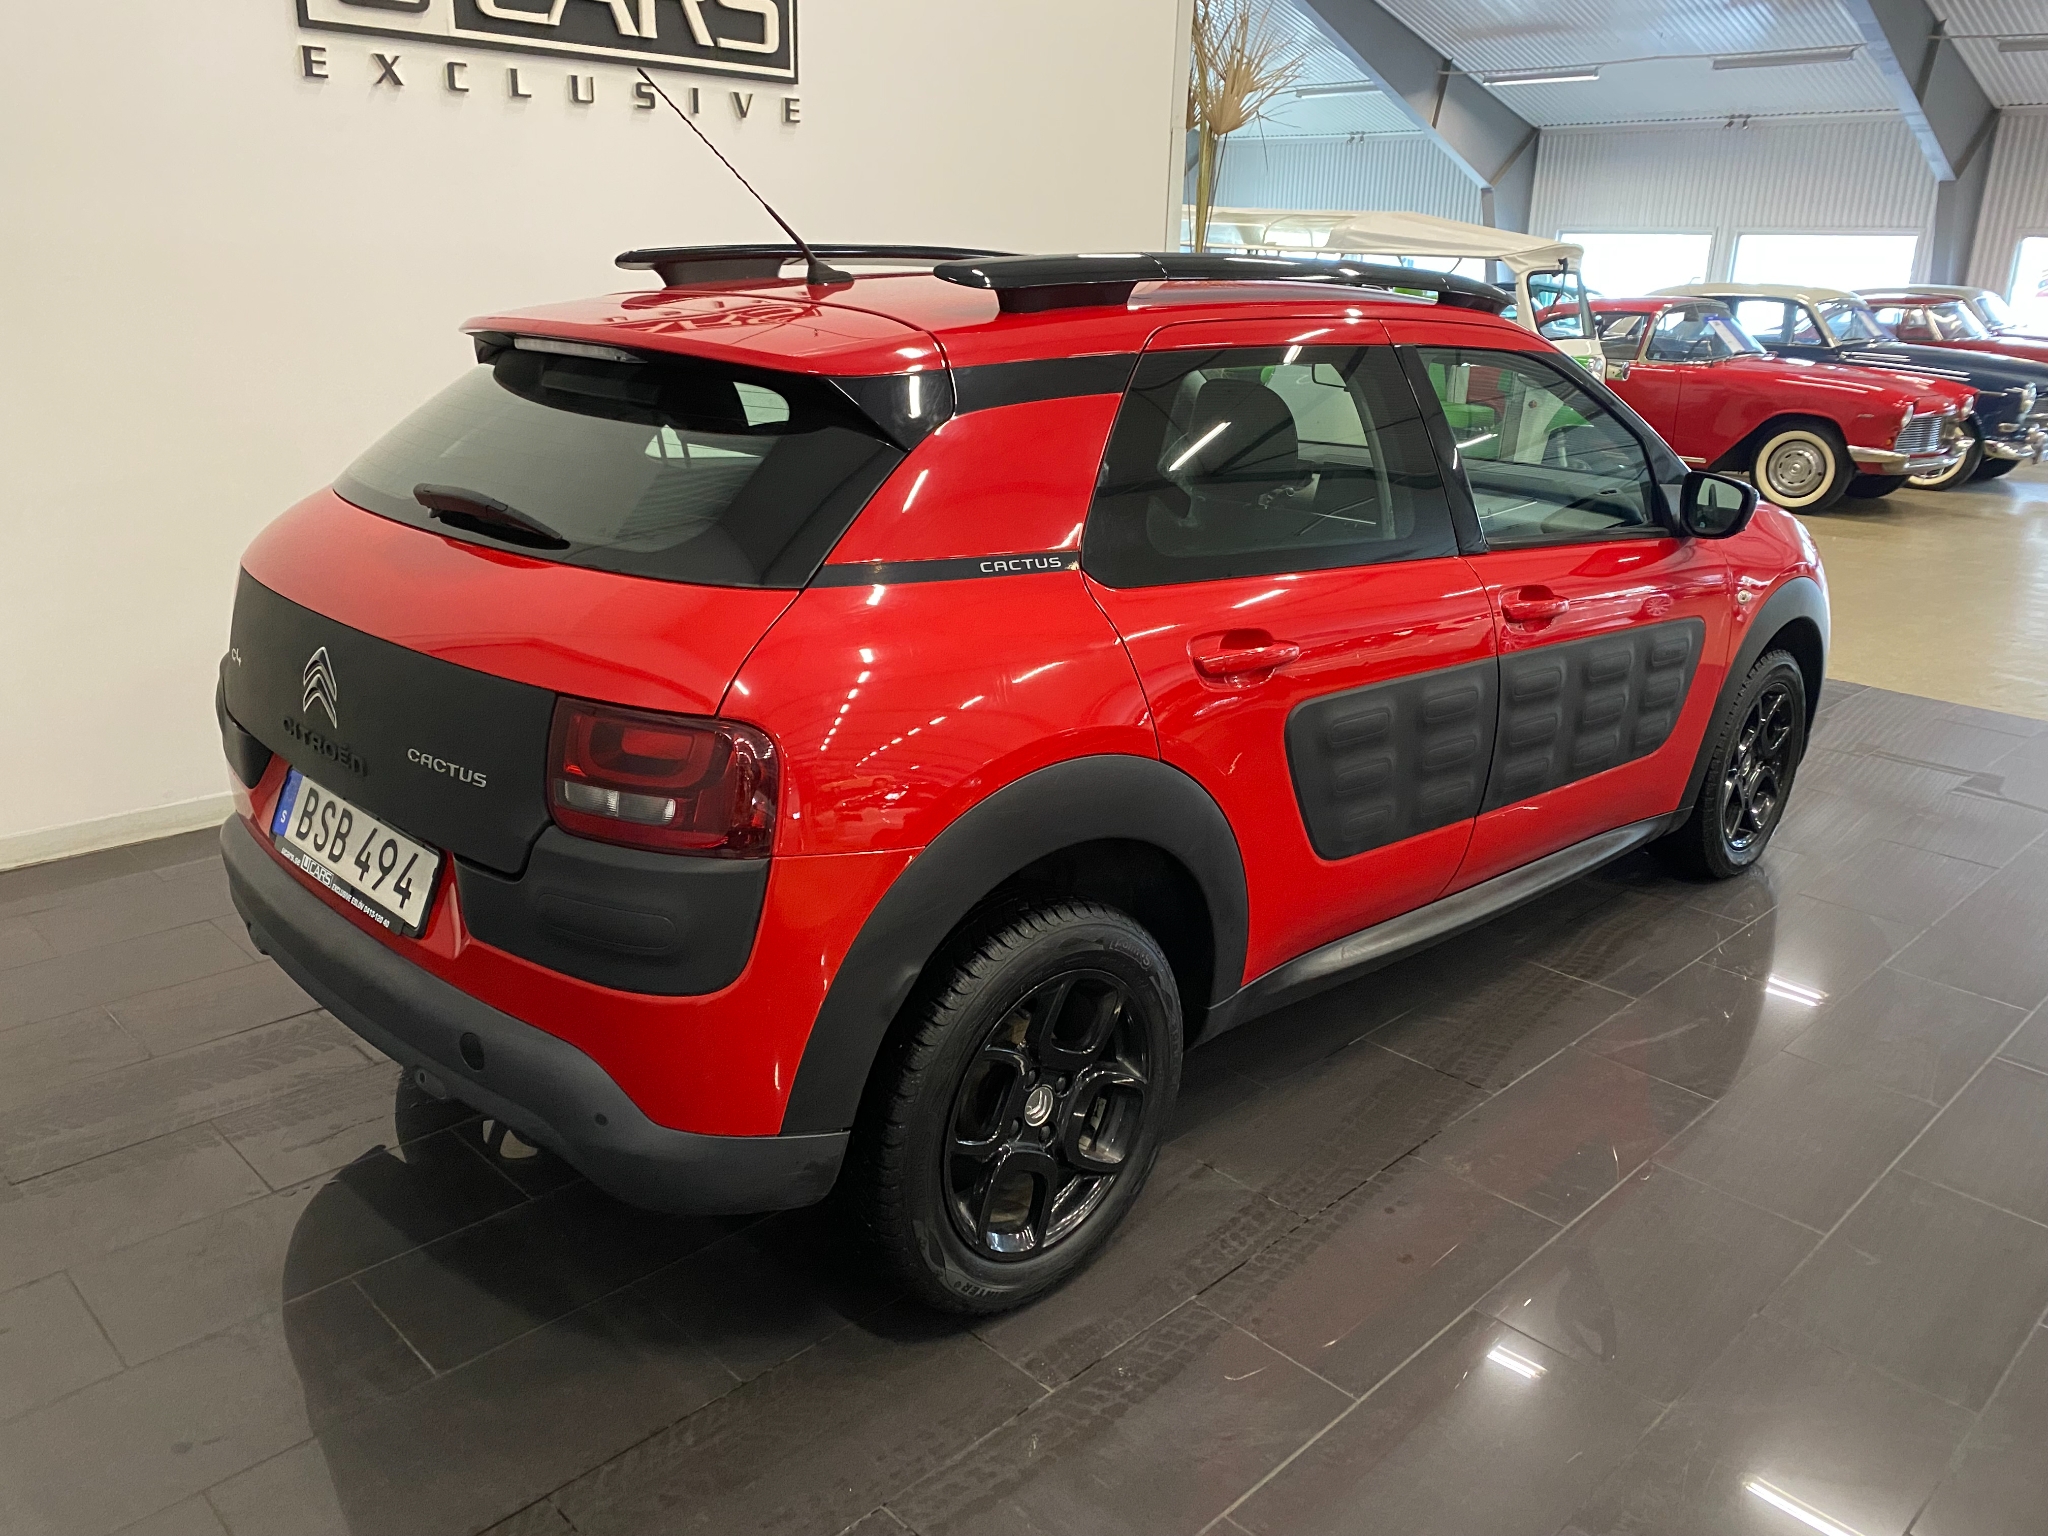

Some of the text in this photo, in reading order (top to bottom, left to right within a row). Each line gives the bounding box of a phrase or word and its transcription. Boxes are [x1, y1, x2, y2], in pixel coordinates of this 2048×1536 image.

[301, 45, 801, 124] EXCLUSIVE
[979, 557, 1062, 573] CACTUS
[231, 647, 242, 667] C4
[407, 748, 487, 788] CACTUS
[280, 810, 288, 824] S
[295, 787, 419, 909] BSB 494
